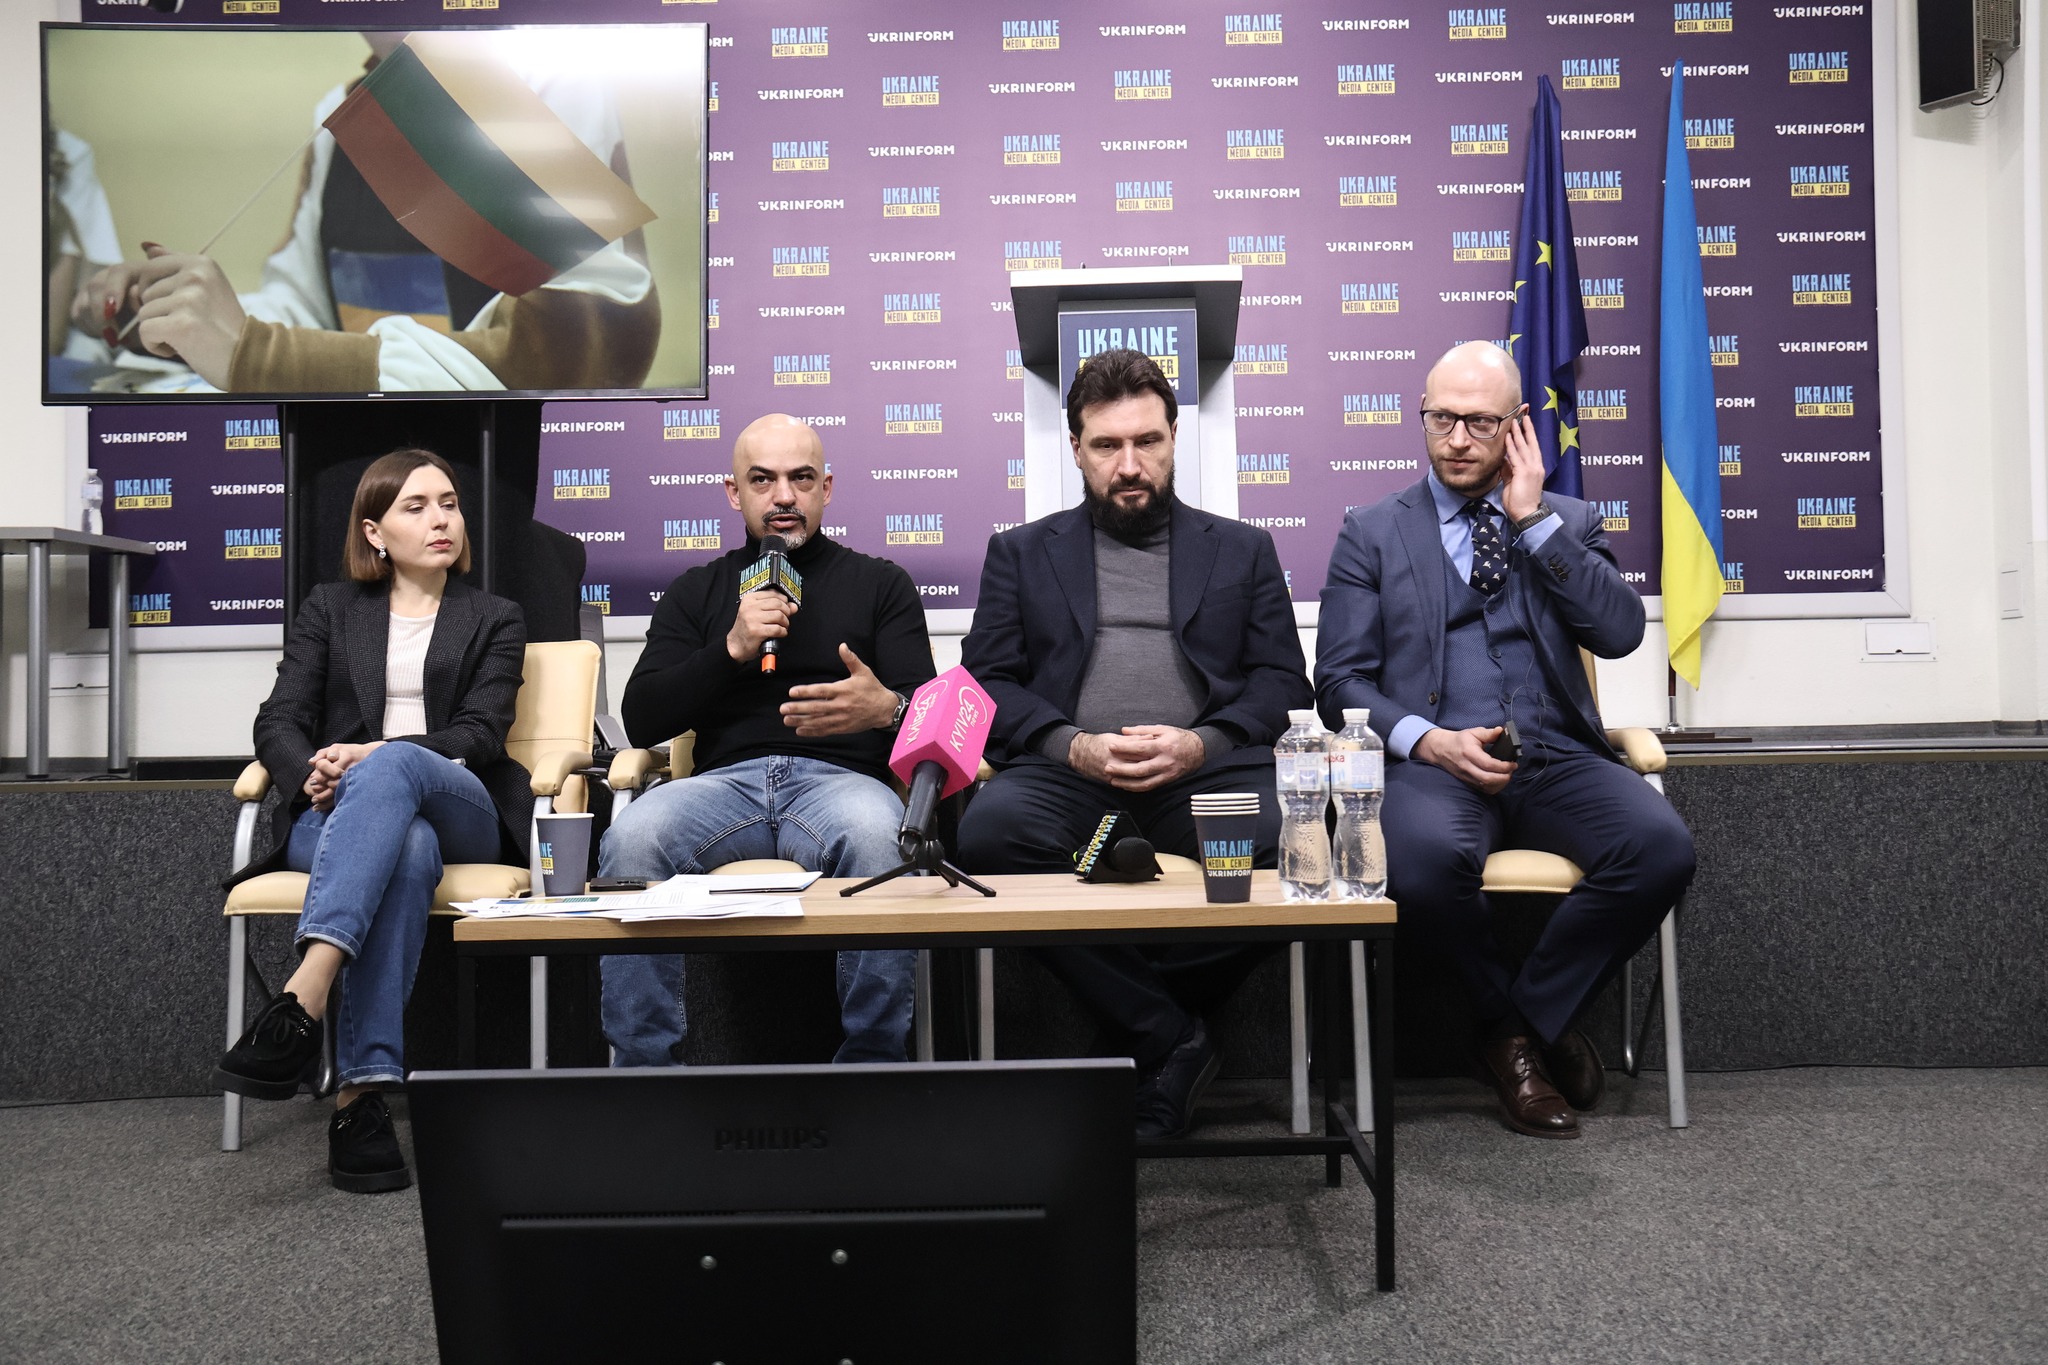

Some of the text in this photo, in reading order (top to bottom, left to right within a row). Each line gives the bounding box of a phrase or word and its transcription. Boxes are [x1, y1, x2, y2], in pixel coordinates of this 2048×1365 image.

[1674, 2, 1732, 19] UKRAINE
[1774, 5, 1863, 18] UKRINFORM
[1449, 8, 1506, 26] UKRAINE
[1546, 13, 1634, 25] UKRINFORM
[1003, 20, 1059, 36] UKRAINE
[1226, 15, 1282, 32] UKRAINE
[1322, 19, 1409, 31] UKRINFORM
[1677, 20, 1729, 30] MEDIA CENTER
[772, 27, 828, 44] UKRAINE
[1099, 25, 1185, 36] UKRINFORM
[1452, 27, 1503, 36] MEDIA CENTER
[868, 31, 953, 42] UKRINFORM
[1229, 33, 1279, 42] MEDIA CENTER
[1006, 38, 1056, 47] MEDIA CENTER
[775, 45, 825, 54] MEDIA CENTER
[1789, 52, 1848, 69] UKRAINE
[1338, 63, 1395, 80] UKRAINE
[1563, 58, 1620, 76] UKRAINE
[1115, 70, 1171, 86] UKRAINE
[1435, 71, 1522, 83] UKRINFORM
[1792, 70, 1845, 80] MEDIA CENTER
[882, 76, 938, 92] UKRAINE
[989, 82, 1075, 93] UKRINFORM
[1212, 76, 1298, 88] UKRINFORM
[1341, 83, 1392, 92] MEDIA CENTER
[1566, 77, 1617, 87] MEDIA CENTER
[758, 89, 843, 100] UKRINFORM
[1118, 88, 1168, 97] MEDIA CENTER
[885, 94, 935, 103] MEDIA CENTER
[1451, 125, 1508, 140] UKRAINE
[1775, 123, 1864, 135] UKRINFORM
[1004, 135, 1060, 150] UKRAINE
[1227, 129, 1283, 146] UKRAINE
[1324, 135, 1411, 146] UKRINFORM
[772, 141, 828, 158] UKRAINE
[868, 145, 954, 156] UKRINFORM
[1101, 140, 1187, 151] UKRINFORM
[1454, 143, 1505, 152] MEDIA CENTER
[1007, 153, 1057, 162] MEDIA CENTER
[1230, 148, 1280, 157] MEDIA CENTER
[775, 159, 825, 168] MEDIA CENTER
[1564, 171, 1622, 188] UKRAINE
[1791, 165, 1849, 183] UKRAINE
[1340, 175, 1397, 192] UKRAINE
[1437, 183, 1524, 194] UKRINFORM
[1794, 183, 1846, 194] MEDIA CENTER
[1116, 181, 1172, 198] UKRAINE
[1213, 188, 1299, 199] UKRINFORM
[883, 187, 939, 204] UKRAINE
[990, 194, 1076, 205] UKRINFORM
[1343, 194, 1394, 203] MEDIA CENTER
[758, 200, 844, 211] UKRINFORM
[1119, 199, 1169, 208] MEDIA CENTER
[886, 205, 936, 214] MEDIA CENTER
[1454, 231, 1510, 248] UKRAINE
[1777, 231, 1865, 242] UKRINFORM
[1005, 240, 1061, 256] UKRAINE
[1229, 236, 1285, 252] UKRAINE
[1326, 241, 1413, 252] UKRINFORM
[773, 247, 829, 262] UKRAINE
[869, 251, 955, 262] UKRINFORM
[1102, 246, 1188, 257] UKRINFORM
[1457, 249, 1507, 258] MEDIA CENTER
[776, 265, 826, 274] MEDIA CENTER
[1793, 274, 1851, 291] UKRAINE
[1342, 283, 1398, 300] UKRAINE
[1796, 292, 1848, 302] MEDIA CENTER
[884, 294, 940, 310] UKRAINE
[1345, 301, 1395, 310] MEDIA CENTER
[759, 306, 844, 317] UKRINFORM
[887, 312, 937, 321] MEDIA CENTER
[1078, 326, 1178, 357] UKRAINE
[1779, 341, 1867, 352] UKRINFORM
[1328, 350, 1415, 361] UKRINFORM
[774, 355, 830, 372] UKRAINE
[870, 360, 956, 371] UKRINFORM
[777, 373, 827, 382] MEDIA CENTER
[1795, 386, 1853, 403] UKRAINE
[1344, 394, 1401, 412] UKRAINE
[886, 404, 942, 420] UKRAINE
[1798, 404, 1850, 414] MEDIA CENTER
[663, 410, 719, 425] UKRAINE
[1347, 413, 1398, 422] MEDIA CENTER
[541, 422, 624, 433] UKRINFORM
[666, 427, 716, 436] MEDIA CENTER
[889, 423, 939, 432] MEDIA CENTER
[101, 432, 187, 443] UKRINFORM
[1781, 452, 1870, 463] UKRINFORM
[1330, 460, 1417, 471] UKRINFORM
[554, 470, 610, 485] UKRAINE
[871, 469, 957, 480] UKRINFORM
[115, 478, 172, 496] UKRAINE
[557, 487, 607, 496] MEDIA CENTER
[118, 497, 169, 507] MEDIA CENTER
[1798, 497, 1856, 515] UKRAINE
[886, 514, 942, 530] UKRAINE
[1801, 516, 1853, 526] MEDIA CENTER
[664, 520, 720, 536] UKRAINE
[225, 528, 281, 546] UKRAINE
[667, 537, 717, 547] MEDIA CENTER
[889, 533, 939, 542] MEDIA CENTER
[228, 547, 278, 557] MEDIA CENTER
[741, 555, 771, 583] UKRAINE
[1784, 569, 1873, 580] UKRINFORM
[949, 698, 975, 752] KYIV24
[1084, 815, 1118, 873] UKRAINE
[1204, 840, 1253, 857] UKRAINE
[1208, 857, 1251, 868] MEDIA CENTER
[1207, 869, 1252, 878] UKRINFORM
[714, 1129, 828, 1151] PHILIPS
